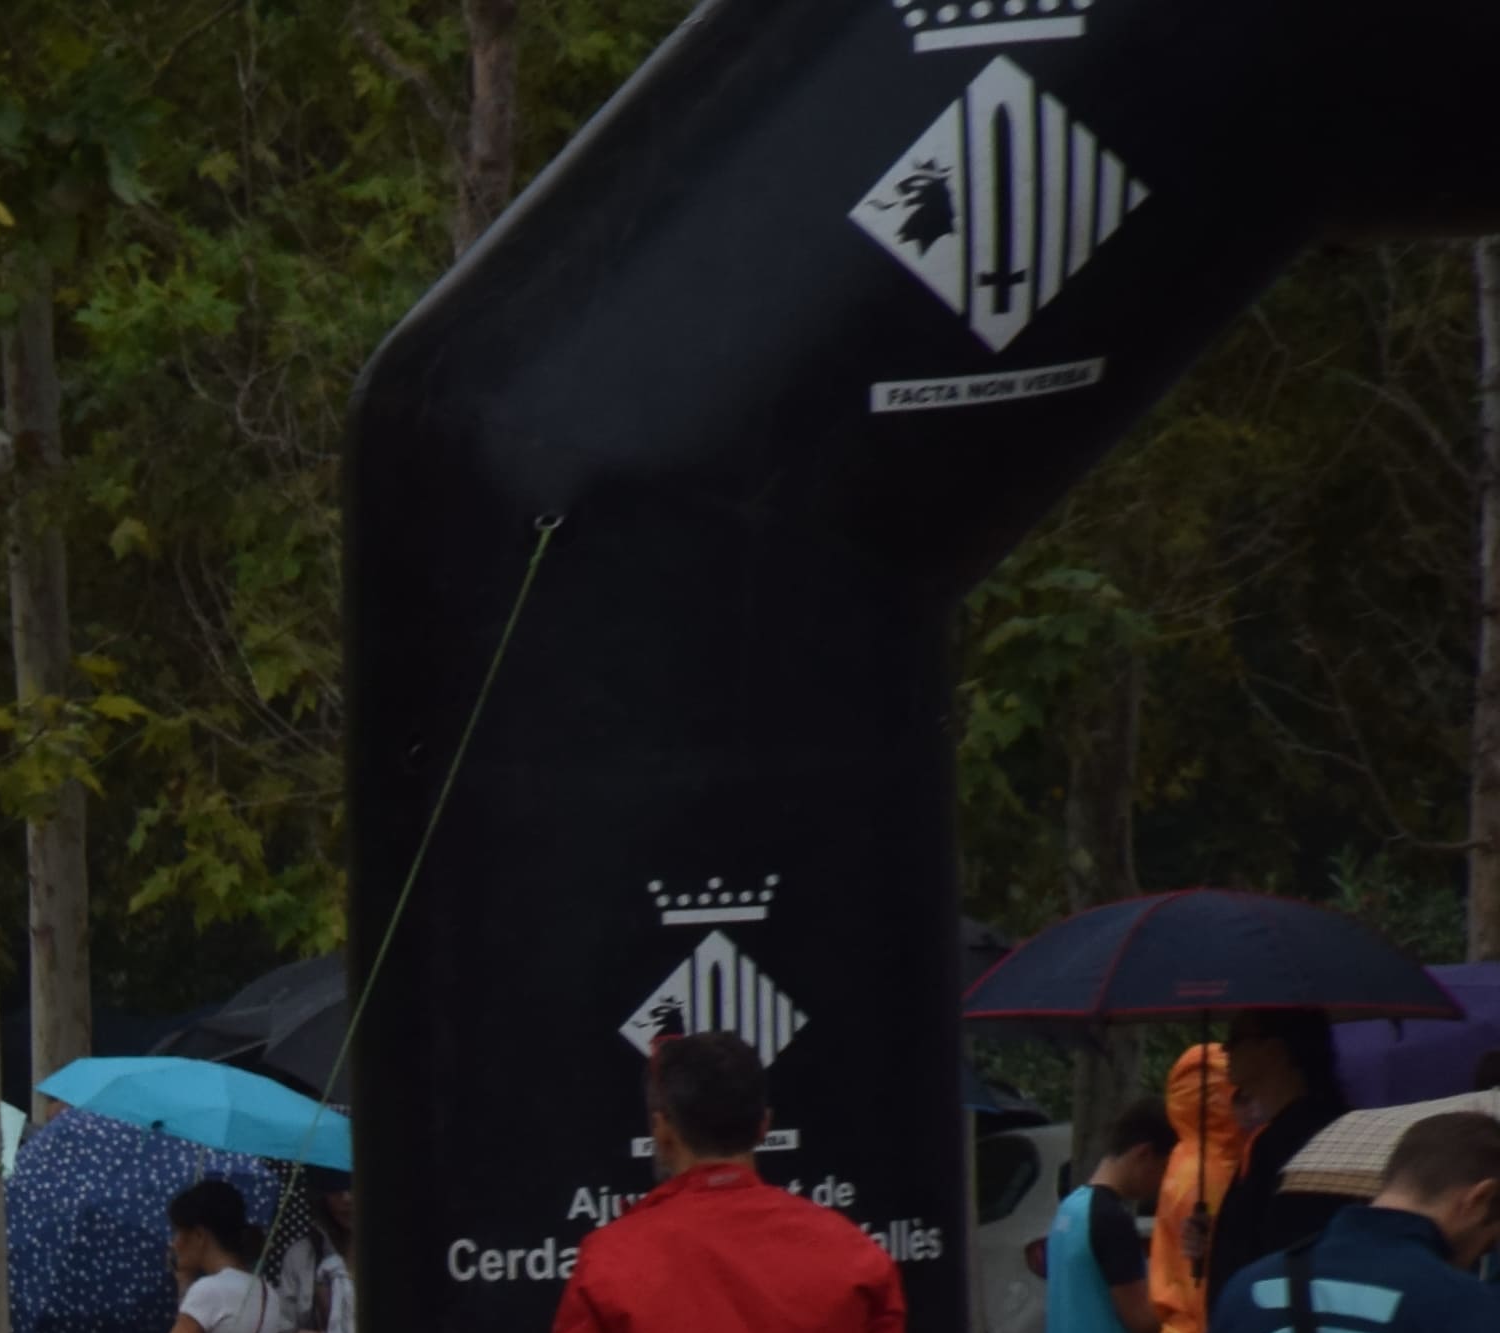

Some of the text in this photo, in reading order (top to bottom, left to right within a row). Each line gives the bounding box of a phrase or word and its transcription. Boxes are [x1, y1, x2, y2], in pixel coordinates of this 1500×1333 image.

[889, 368, 1090, 405] FACTA NON VERBA
[811, 1174, 857, 1208] de
[447, 1237, 581, 1283] Cerda
